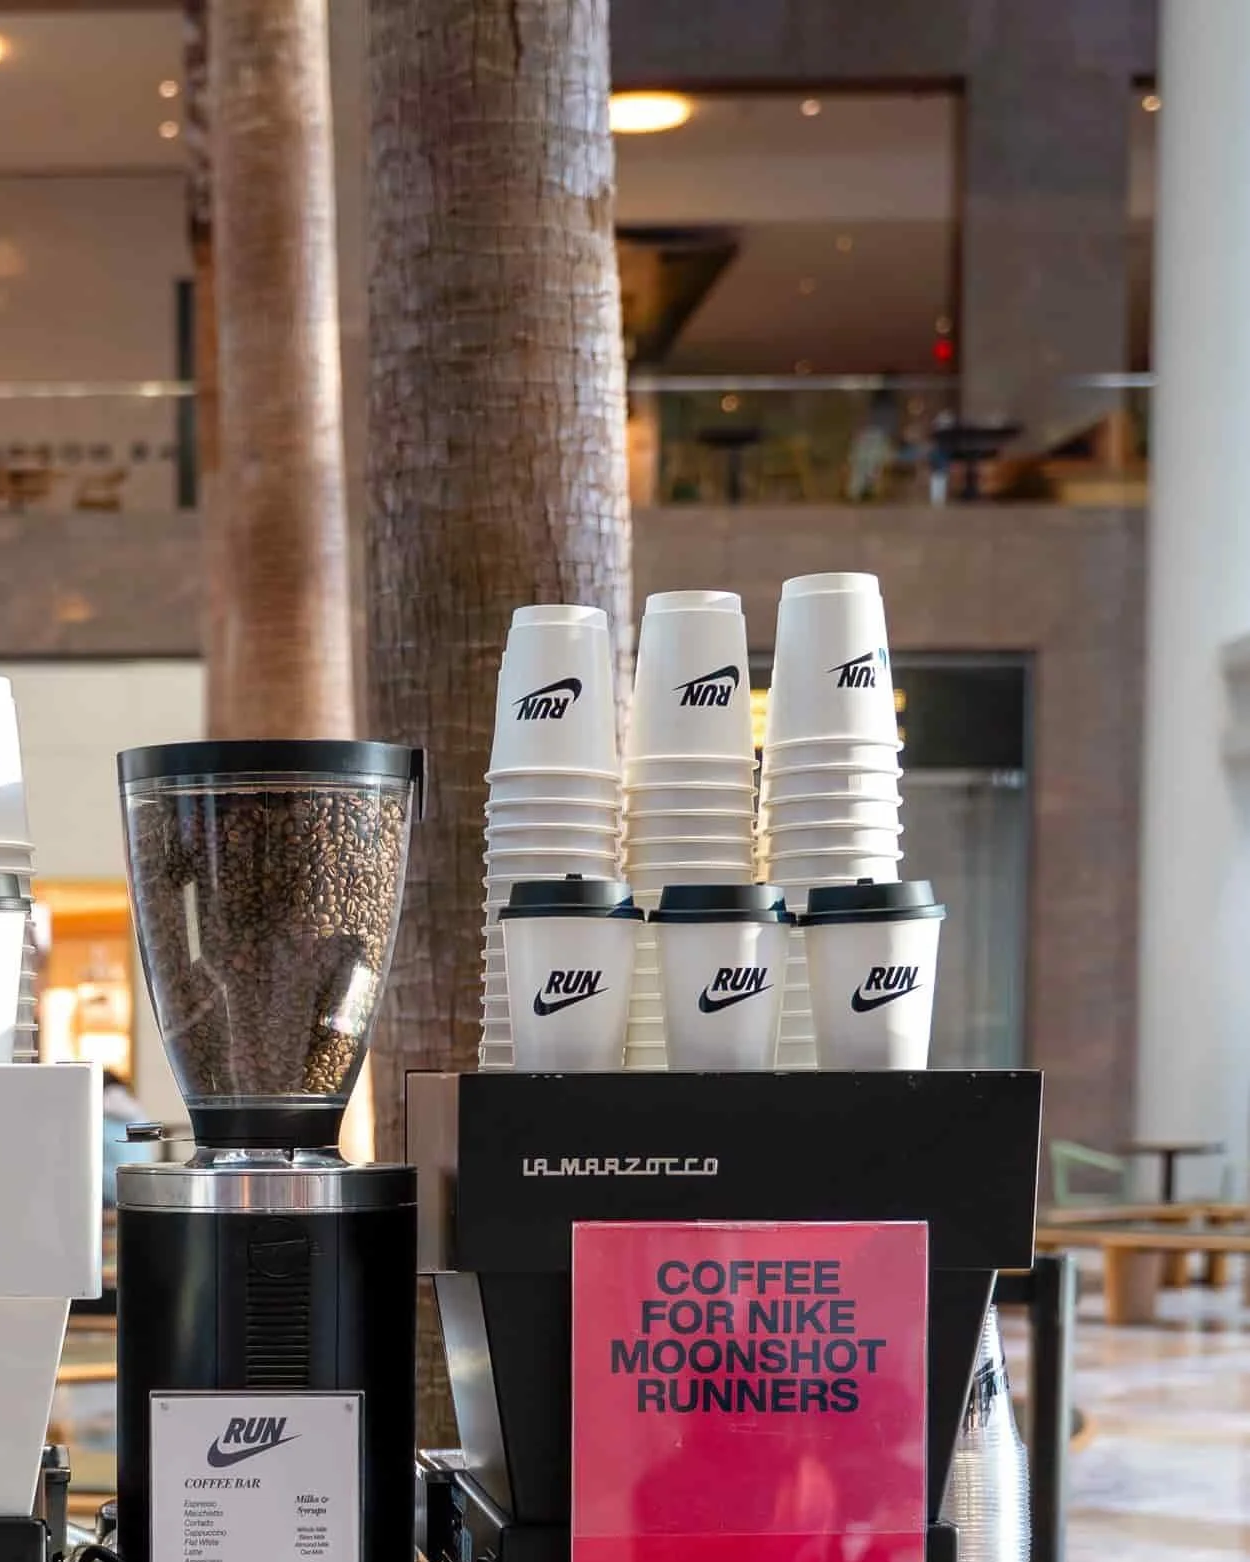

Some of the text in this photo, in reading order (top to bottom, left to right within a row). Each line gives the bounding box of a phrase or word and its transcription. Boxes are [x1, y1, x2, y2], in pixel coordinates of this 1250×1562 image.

[680, 683, 732, 706] RUN
[517, 696, 570, 720] RUN
[545, 969, 602, 994] RUN
[711, 967, 768, 991] RUN
[865, 966, 919, 990] RUN
[523, 1158, 718, 1176] LA MARZOCCO
[656, 1260, 840, 1295] COFFEE
[641, 1299, 855, 1334] FOR NIKE
[611, 1339, 887, 1374] MOONSHOT
[637, 1378, 859, 1413] RUNNERS
[223, 1416, 287, 1444] RUN
[184, 1477, 261, 1489] COFFEE BAR
